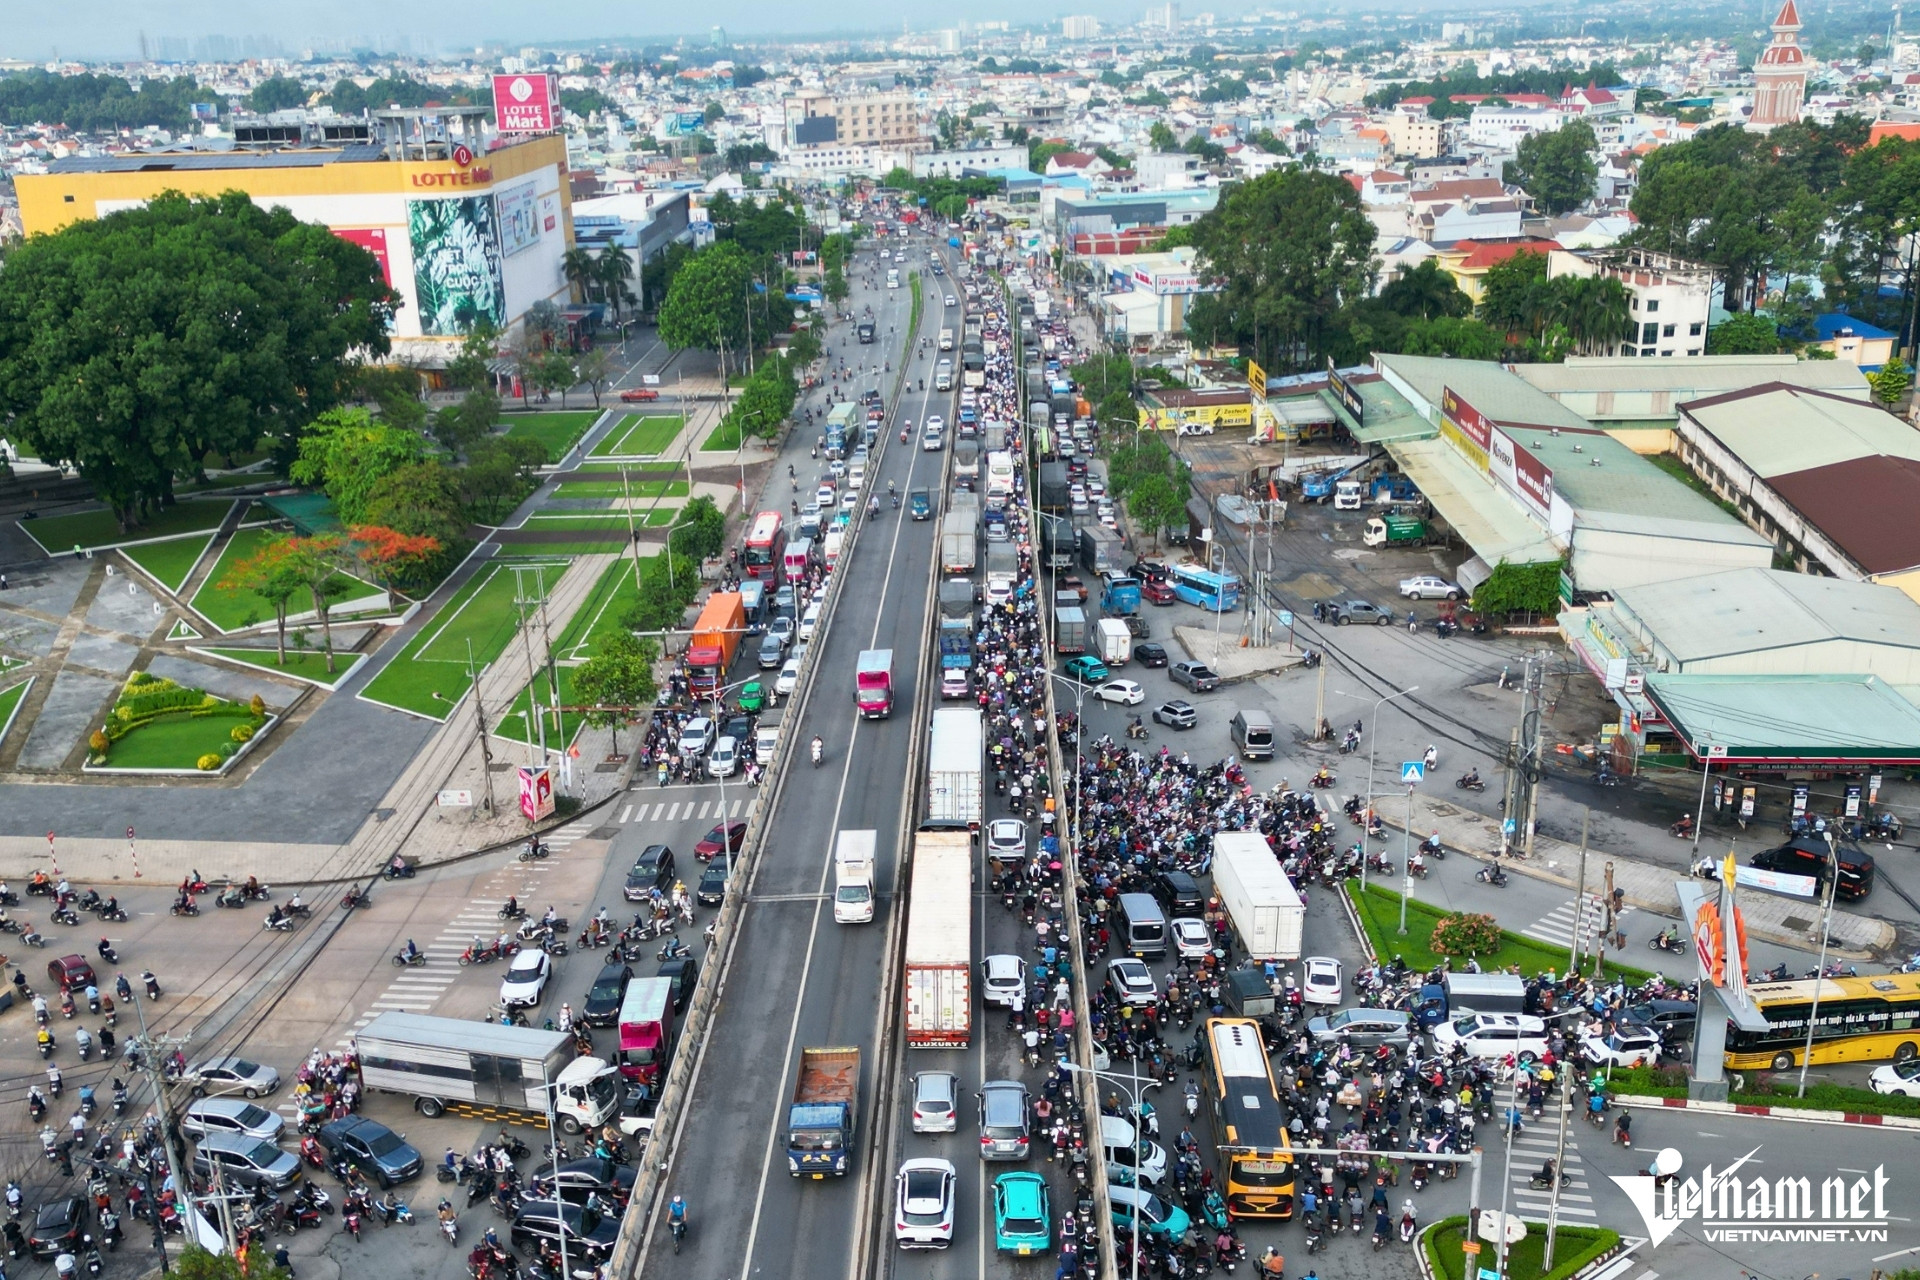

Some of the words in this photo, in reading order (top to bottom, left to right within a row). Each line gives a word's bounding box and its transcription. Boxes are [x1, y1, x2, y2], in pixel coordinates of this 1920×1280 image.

[503, 105, 542, 115] LOTTE
[505, 115, 544, 129] Mart
[412, 172, 469, 187] LOTTE
[446, 275, 478, 289] CUỘC
